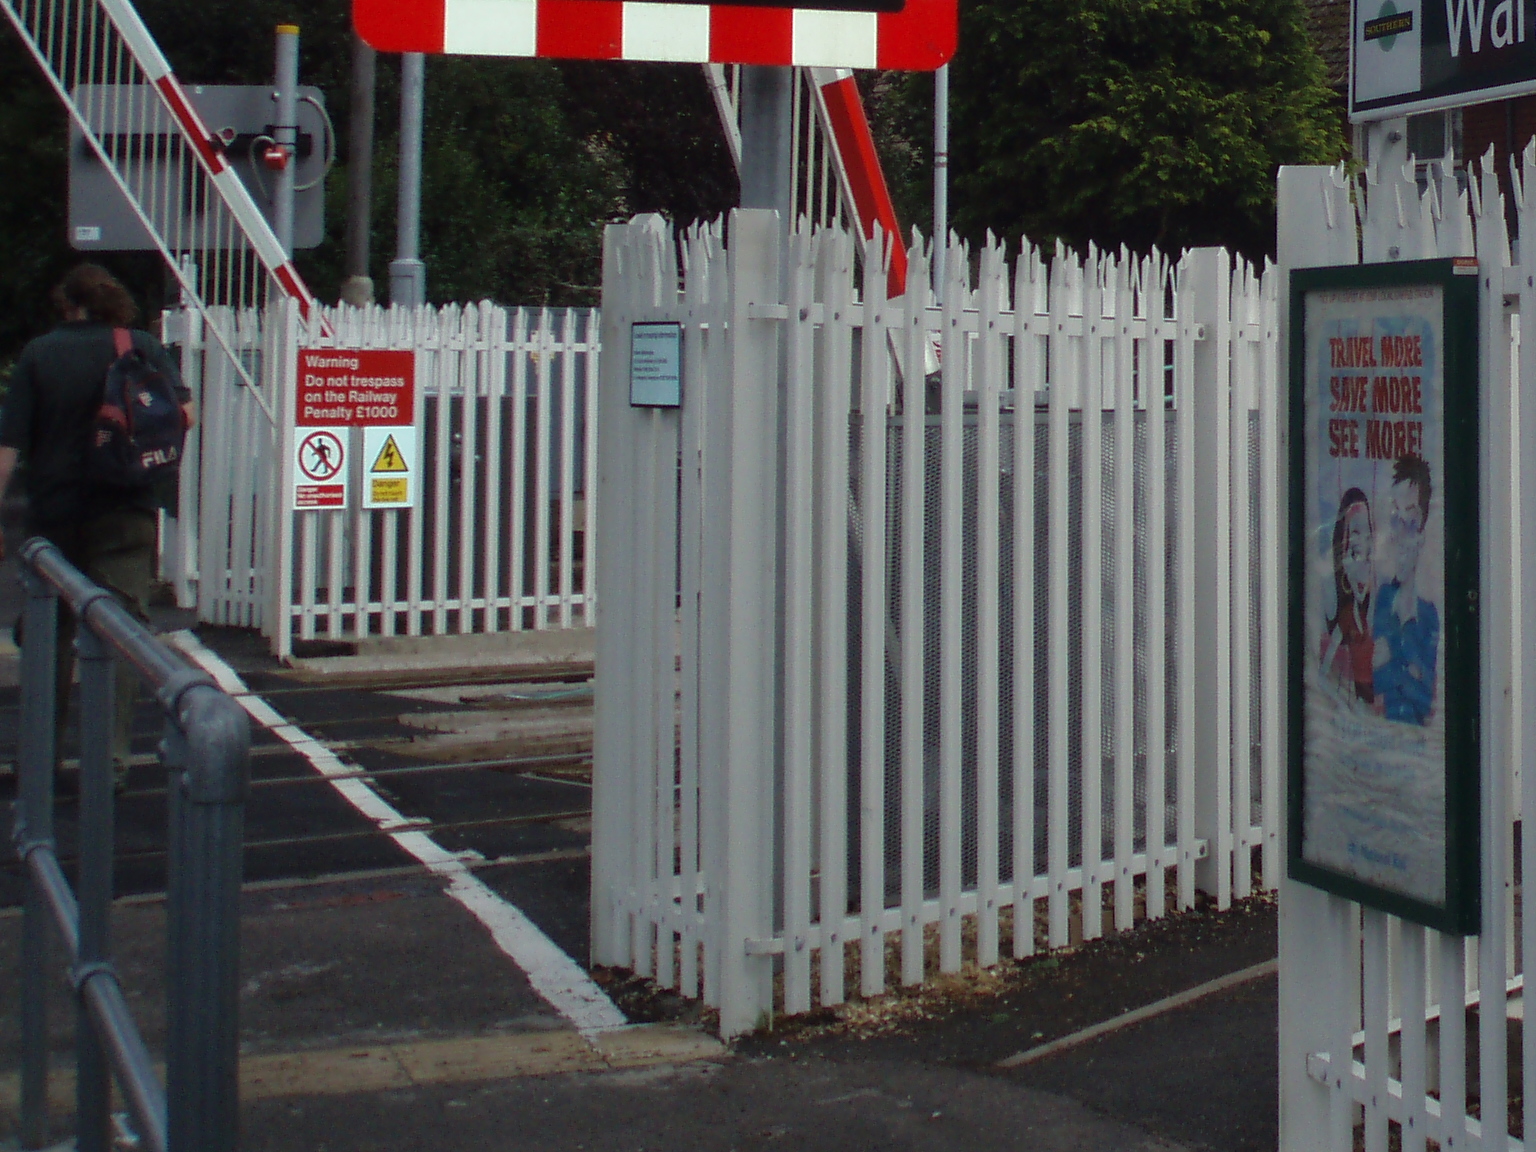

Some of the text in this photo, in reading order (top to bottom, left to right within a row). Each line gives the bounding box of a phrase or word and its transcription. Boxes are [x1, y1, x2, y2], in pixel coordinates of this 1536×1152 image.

[1366, 16, 1411, 35] SOUTHERN
[1329, 335, 1423, 368] TRAVEL MORE
[305, 355, 359, 370] Warning
[305, 374, 405, 390] Do not trespass
[304, 390, 398, 404] on the Railway
[1329, 376, 1422, 414] SAVE MORE
[304, 406, 398, 420] Penalty £1000
[1328, 419, 1423, 461] SEE MORE!
[141, 446, 177, 468] FILA
